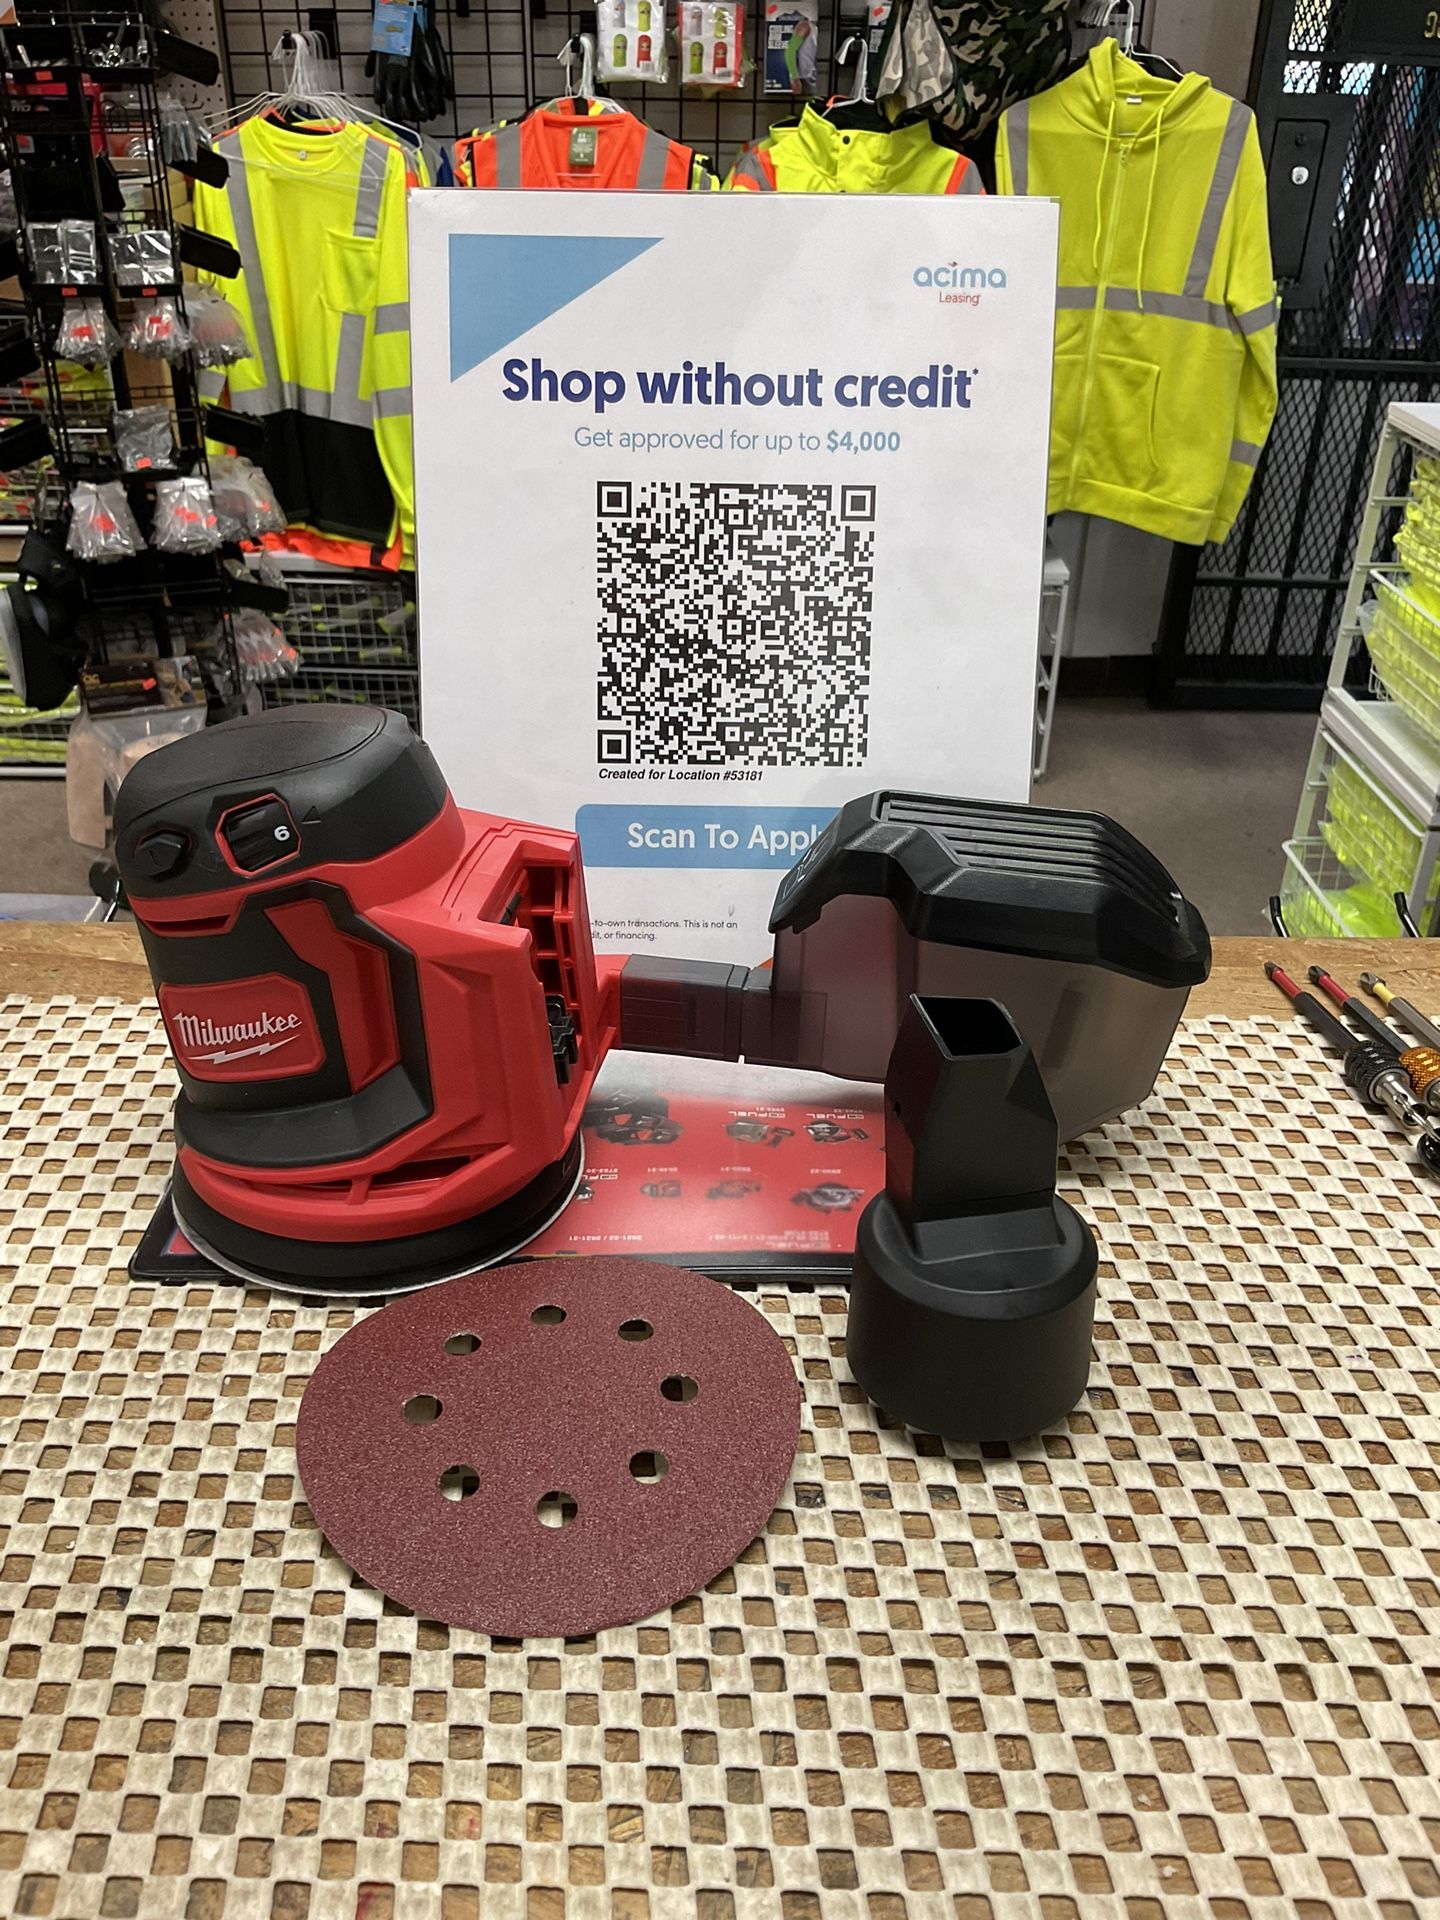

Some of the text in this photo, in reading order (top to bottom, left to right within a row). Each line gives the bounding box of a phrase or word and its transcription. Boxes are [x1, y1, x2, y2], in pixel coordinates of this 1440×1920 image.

[913, 261, 1006, 288] acima
[939, 292, 980, 306] Leasing
[502, 358, 625, 413] Shop
[636, 361, 823, 406] without
[575, 427, 901, 454] Get approved for up to $4,000
[599, 768, 763, 781] Created for Location #53181
[274, 825, 290, 841] 6
[627, 823, 822, 856] Scan To Appl
[591, 919, 626, 928] -to-own
[628, 919, 681, 928] transactions.
[684, 919, 700, 929] This
[702, 920, 709, 929] is
[711, 920, 724, 929] not
[604, 932, 613, 940] or
[616, 931, 657, 942] financing.
[172, 1012, 303, 1048] Milwaukee
